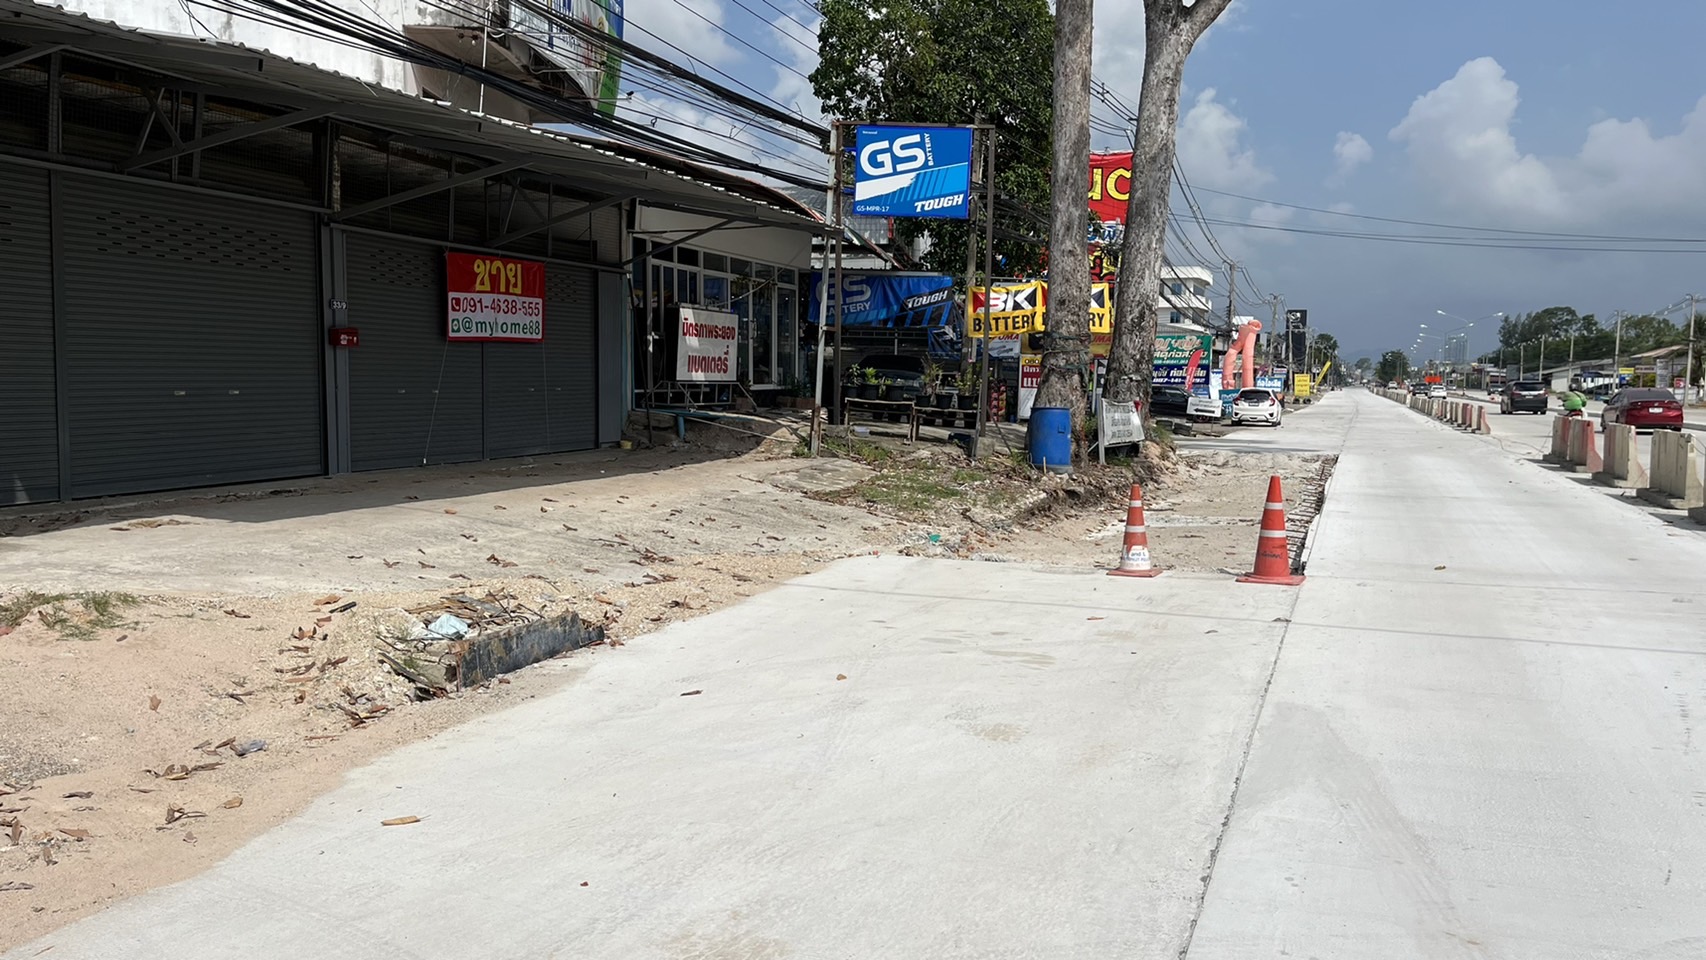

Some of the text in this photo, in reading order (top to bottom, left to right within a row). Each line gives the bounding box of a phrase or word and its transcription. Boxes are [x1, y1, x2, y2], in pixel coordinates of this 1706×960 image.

[860, 134, 926, 176] GS
[923, 132, 935, 166] BATTERY
[914, 194, 964, 213] TOUGH
[473, 259, 522, 294] ขาย
[462, 297, 540, 317] 091-4638-555
[826, 302, 871, 316] ATERY
[907, 290, 948, 309] TOUGH
[977, 287, 1037, 314] BK
